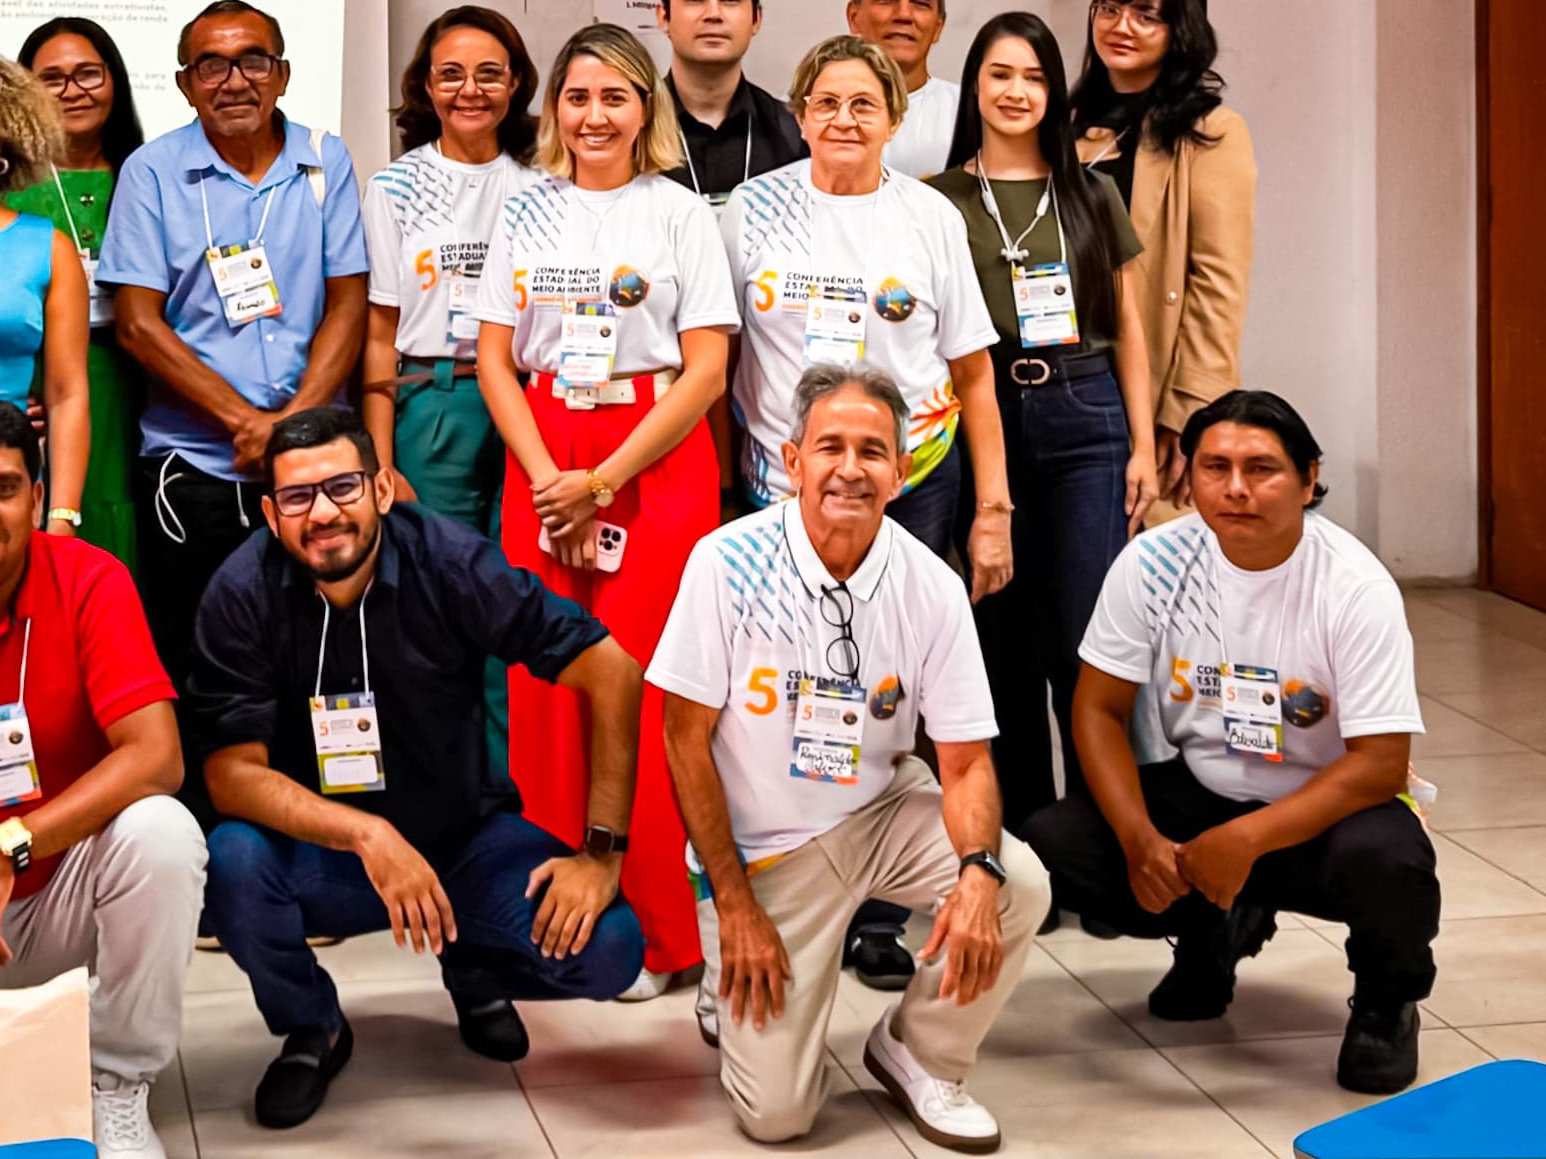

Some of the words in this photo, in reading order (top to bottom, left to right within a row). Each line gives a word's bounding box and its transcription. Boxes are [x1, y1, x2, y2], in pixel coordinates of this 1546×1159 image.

[414, 249, 438, 291] 5
[513, 269, 527, 311] 5
[755, 270, 778, 312] 5
[745, 667, 779, 715] 5
[1170, 656, 1194, 702] 5
[803, 705, 812, 720] 5
